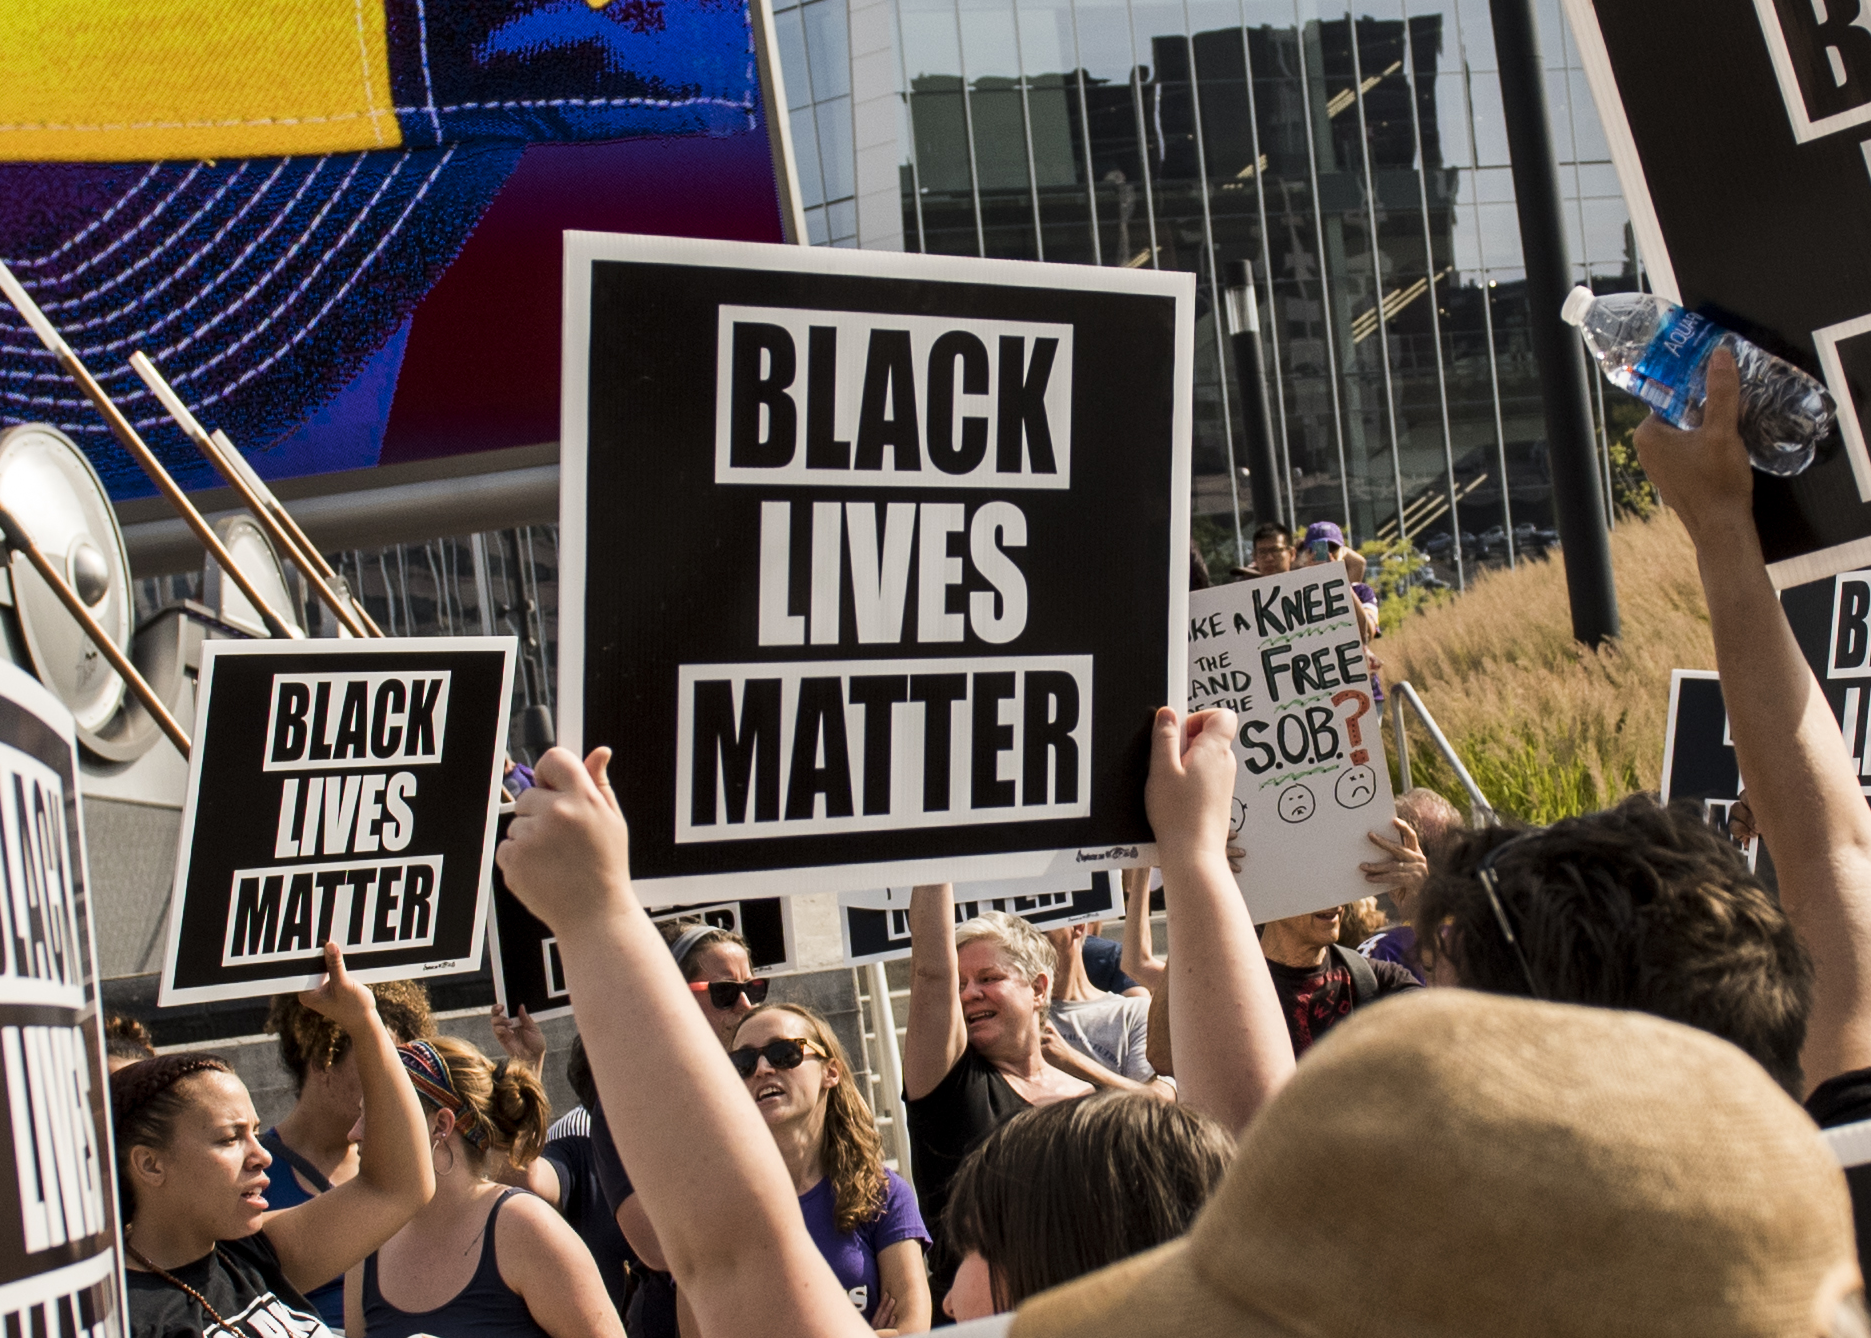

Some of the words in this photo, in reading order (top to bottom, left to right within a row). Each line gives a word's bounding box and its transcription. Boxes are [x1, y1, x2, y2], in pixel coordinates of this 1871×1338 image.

[730, 321, 1059, 476] BLACK
[757, 501, 1029, 647] LIVES
[1233, 612, 1251, 634] A
[1252, 578, 1350, 637] KNEE
[1187, 670, 1252, 702] AND
[1261, 640, 1368, 702] FREE
[1195, 651, 1232, 672] THE
[271, 678, 444, 763] BLACK
[691, 670, 1081, 827] MATTER
[274, 771, 417, 859] LIVES
[230, 864, 435, 958] MATTER
